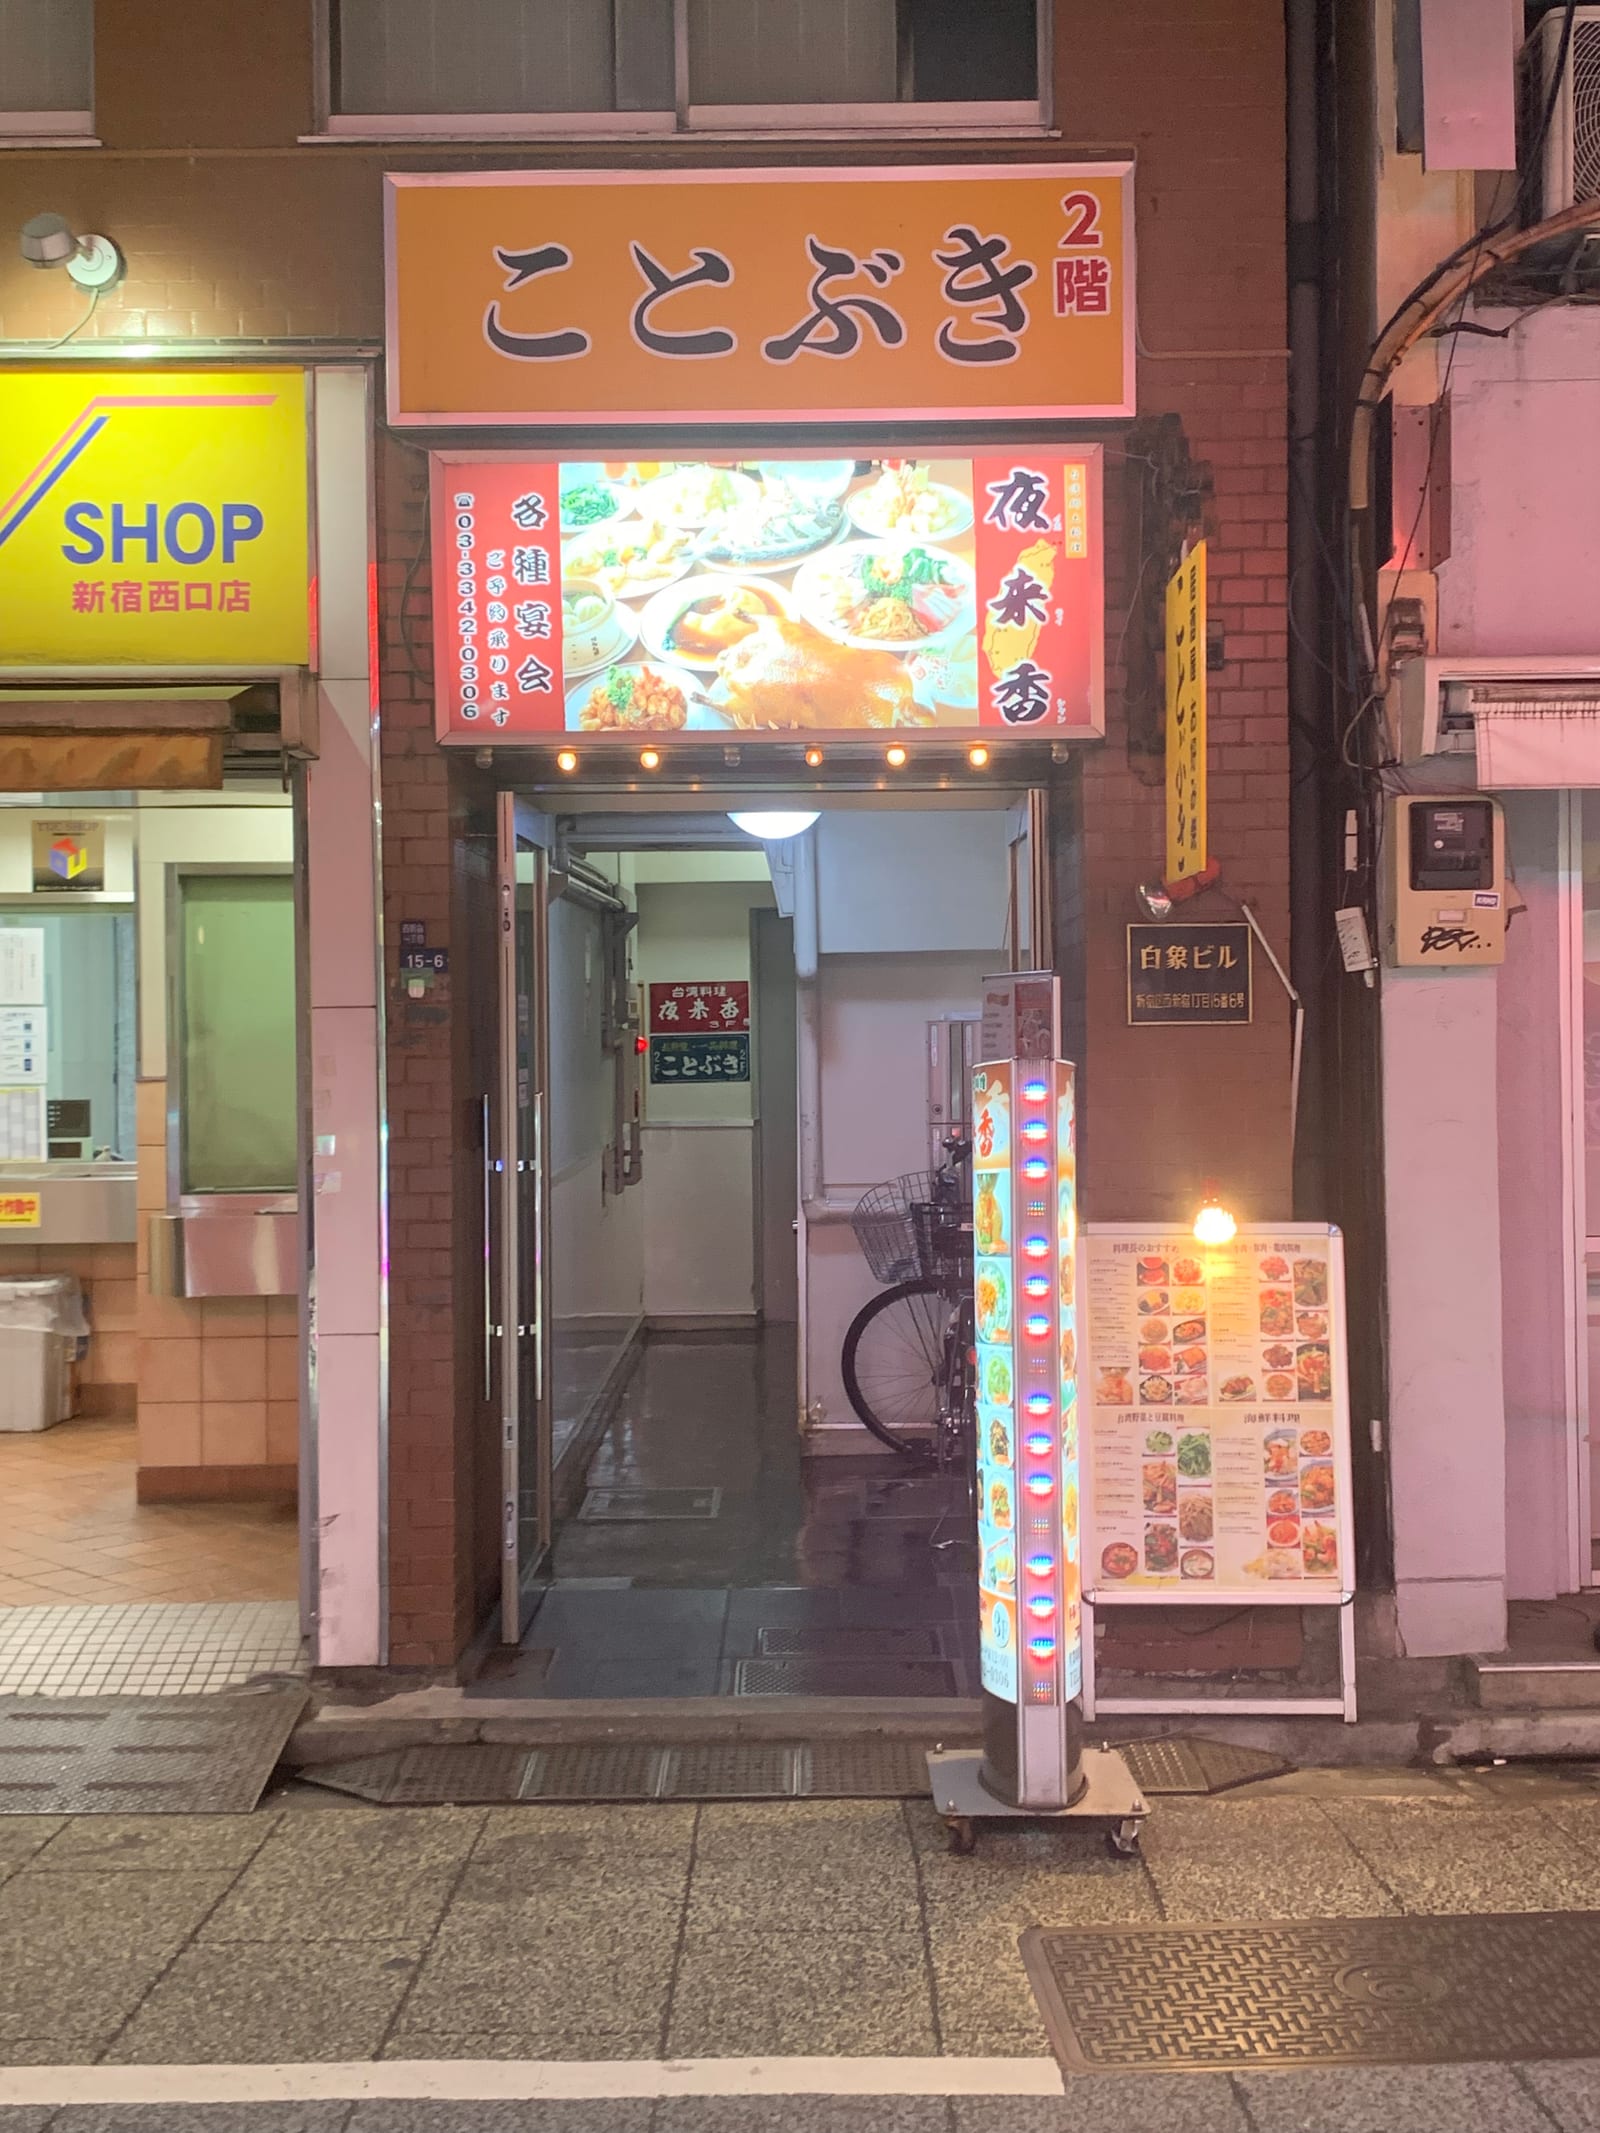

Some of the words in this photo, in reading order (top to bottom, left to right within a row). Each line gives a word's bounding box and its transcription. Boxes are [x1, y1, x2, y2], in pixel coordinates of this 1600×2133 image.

[1055, 191, 1112, 316] 2階
[484, 225, 1038, 366] ことぶき
[61, 502, 264, 565] SHOP
[72, 580, 251, 613] 新宿西口店
[457, 514, 480, 720] 03-3342-0306
[512, 494, 554, 694] 各種宴会
[983, 469, 1053, 726] 夜来香
[486, 550, 510, 727] ご予約承ります
[407, 954, 444, 968] 15-6
[1140, 945, 1238, 969] 白象ビル
[658, 997, 739, 1020] 夜来香
[672, 986, 727, 998] 台湾料理
[661, 1054, 739, 1076] ことぶき
[1243, 1412, 1301, 1424] 海鮮料理
